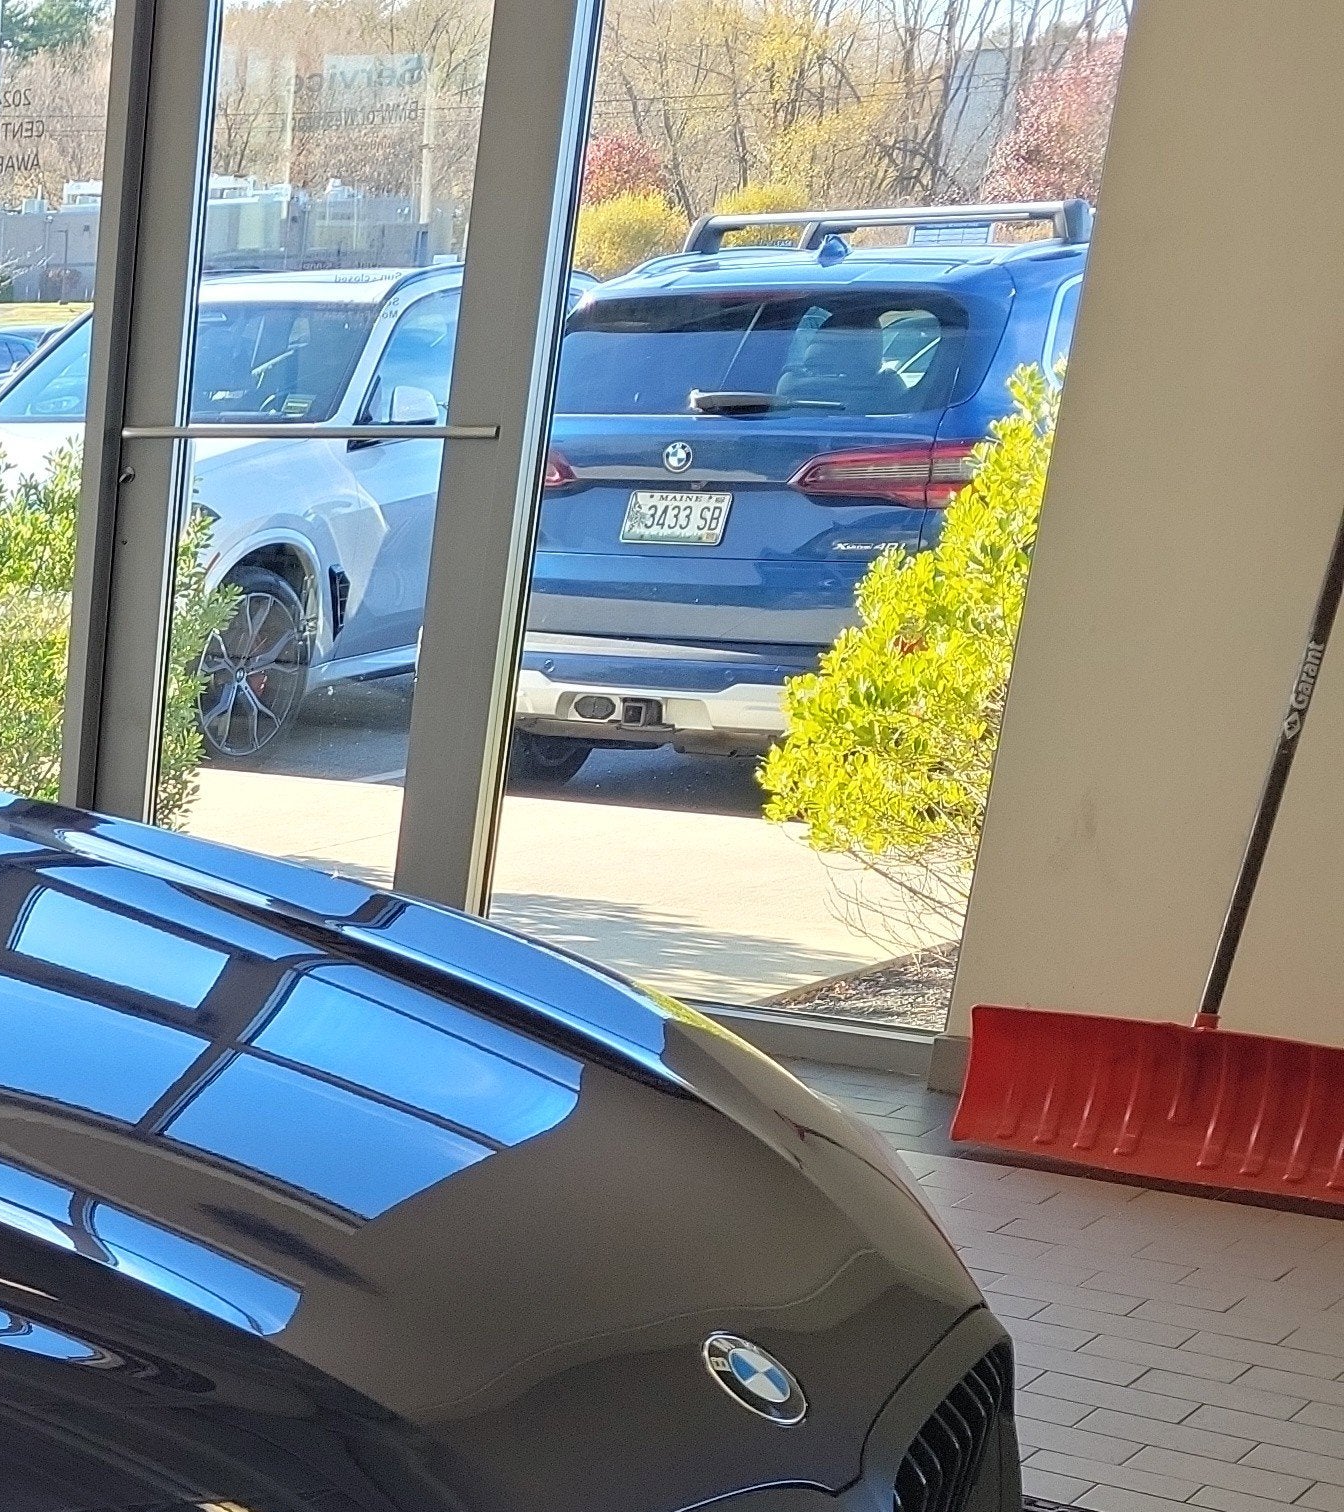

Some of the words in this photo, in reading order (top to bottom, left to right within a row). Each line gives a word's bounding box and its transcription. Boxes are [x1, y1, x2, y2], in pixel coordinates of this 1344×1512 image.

[658, 494, 703, 503] MAINE
[644, 504, 694, 531] 3433
[696, 505, 723, 532] SB
[1292, 639, 1325, 711] Garant
